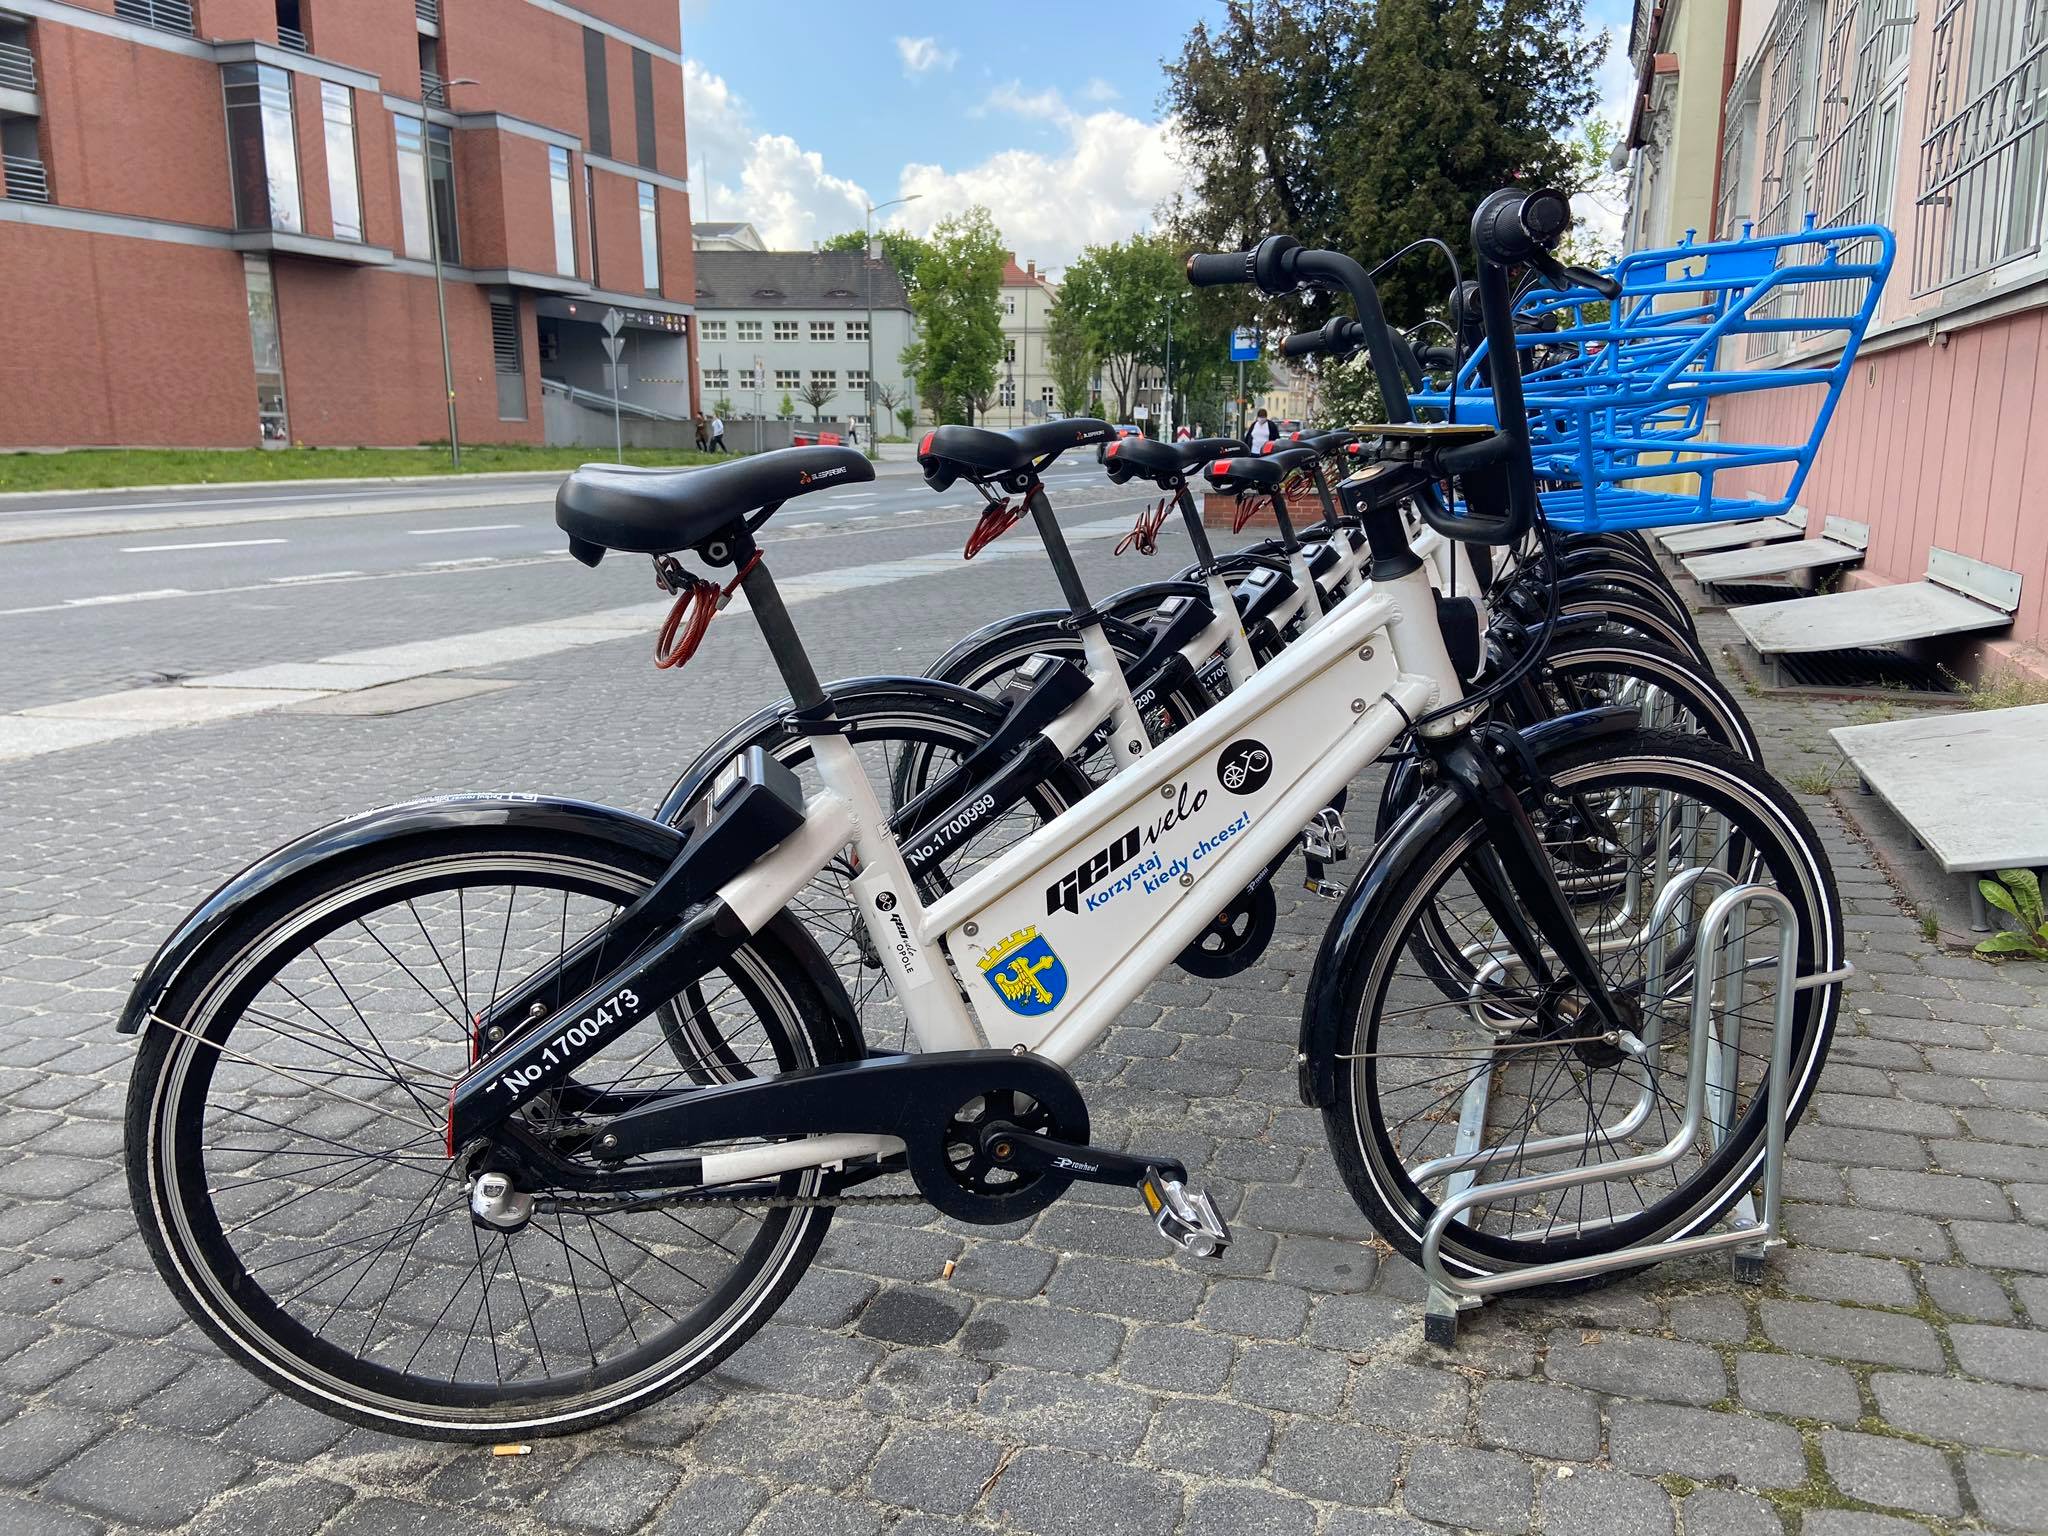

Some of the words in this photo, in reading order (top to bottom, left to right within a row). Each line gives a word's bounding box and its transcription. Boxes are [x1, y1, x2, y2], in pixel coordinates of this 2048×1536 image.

[1086, 851, 1162, 912] Korzystaj
[1143, 857, 1189, 894] kiedy
[1192, 810, 1251, 860] chcesz!
[896, 944, 914, 973] OPOLE
[502, 989, 639, 1095] No.1700473
